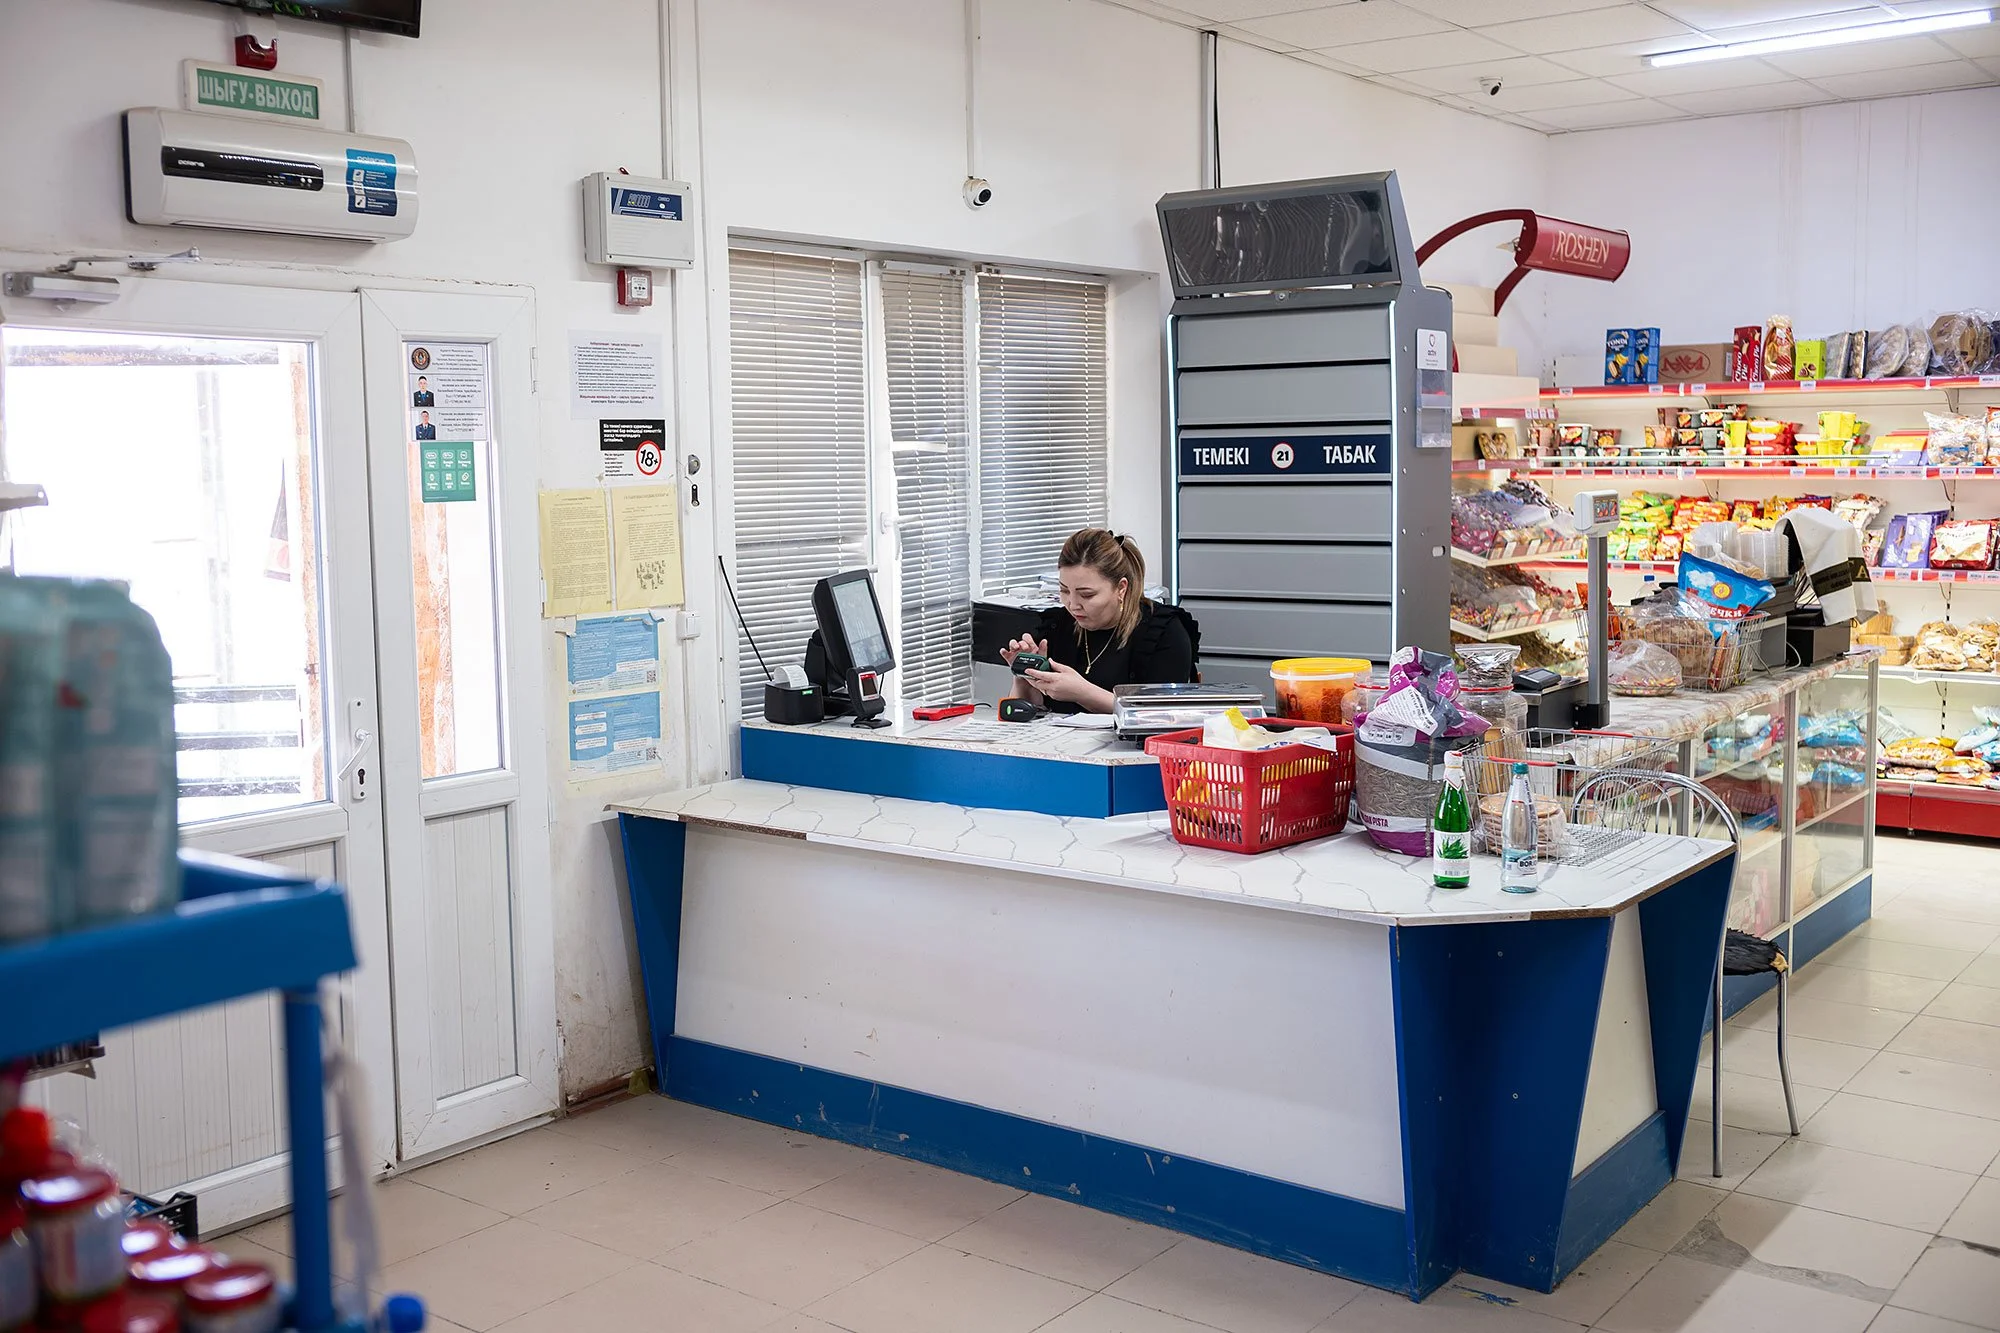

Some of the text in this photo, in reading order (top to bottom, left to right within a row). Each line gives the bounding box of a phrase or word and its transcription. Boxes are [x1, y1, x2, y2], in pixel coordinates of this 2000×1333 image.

[1556, 230, 1610, 264] ROSHEN
[640, 449, 659, 467] 18+
[1193, 445, 1377, 466] ТЕМЕКІ 21 ТАБАК
